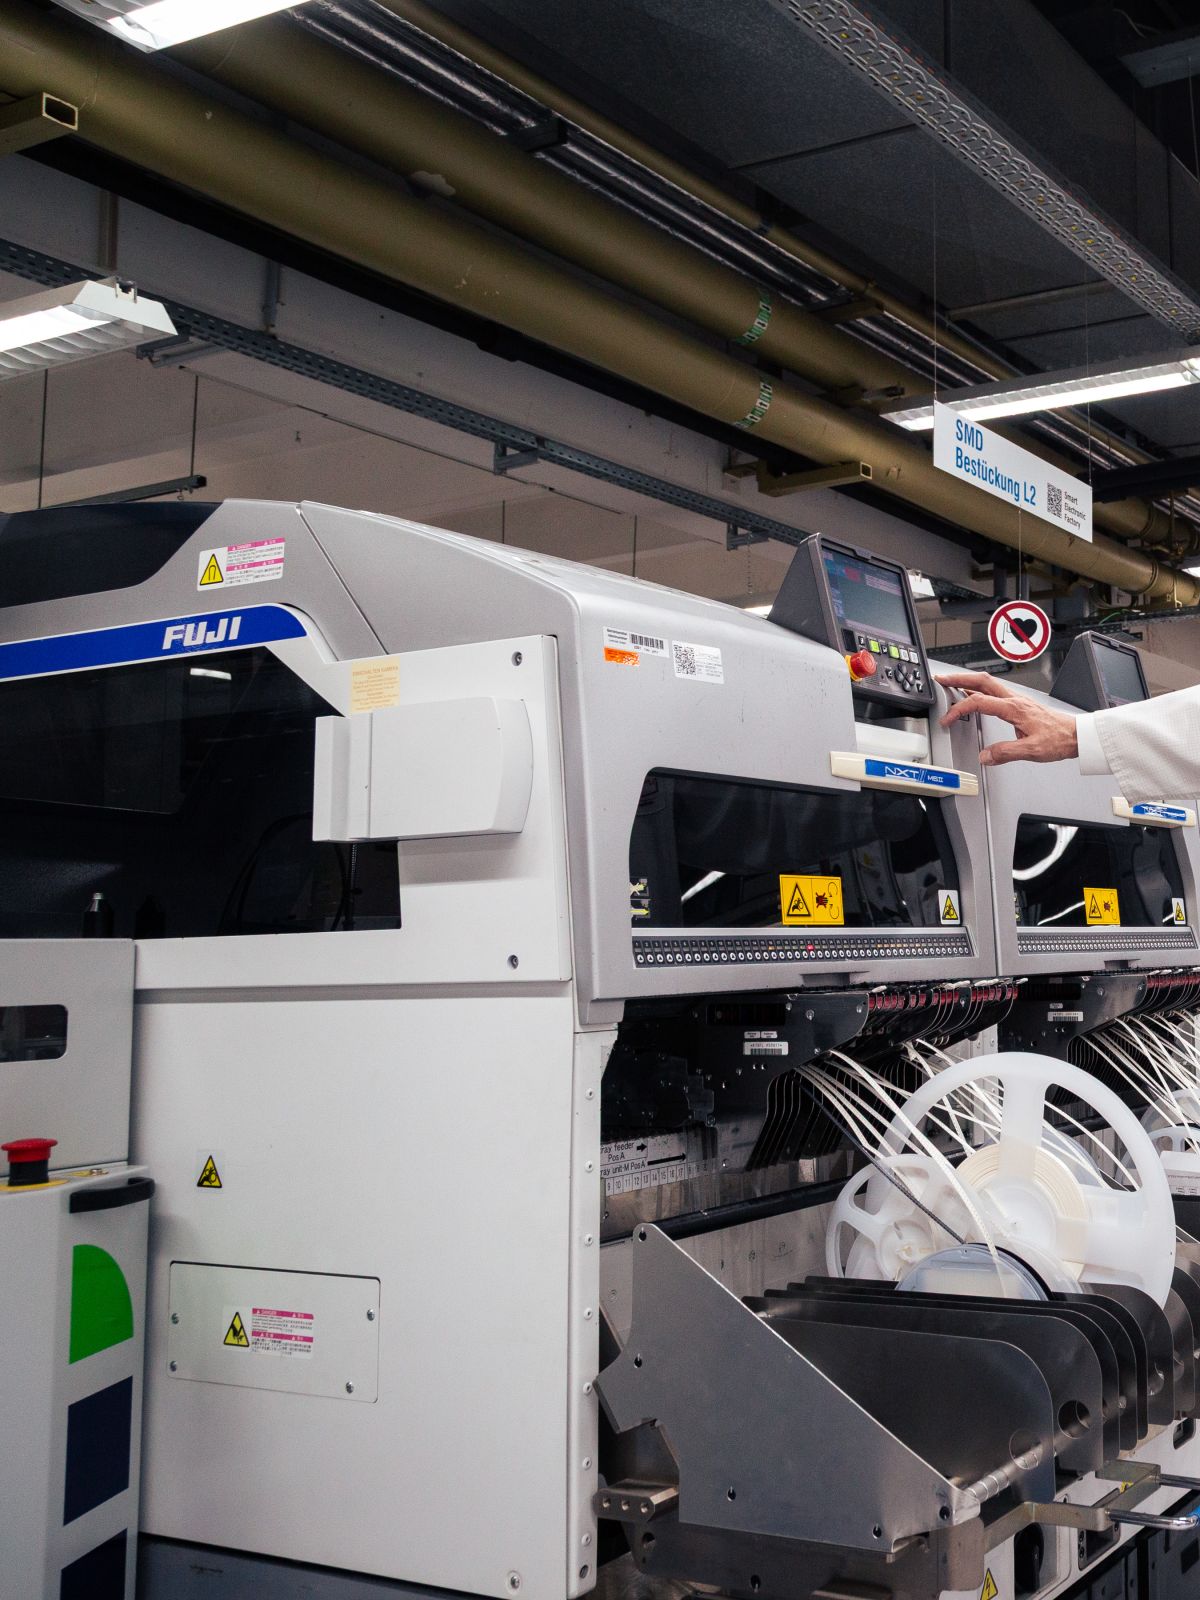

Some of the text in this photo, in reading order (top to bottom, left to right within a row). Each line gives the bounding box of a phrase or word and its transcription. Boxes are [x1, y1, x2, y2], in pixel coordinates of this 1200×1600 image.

[956, 419, 983, 451] SMD
[956, 447, 1036, 506] Bestückung L2
[1064, 491, 1078, 505] Smart
[1064, 502, 1086, 521] Electronic
[1064, 514, 1081, 530] Factory
[162, 616, 241, 650] FUJI
[614, 1140, 634, 1151] feeder
